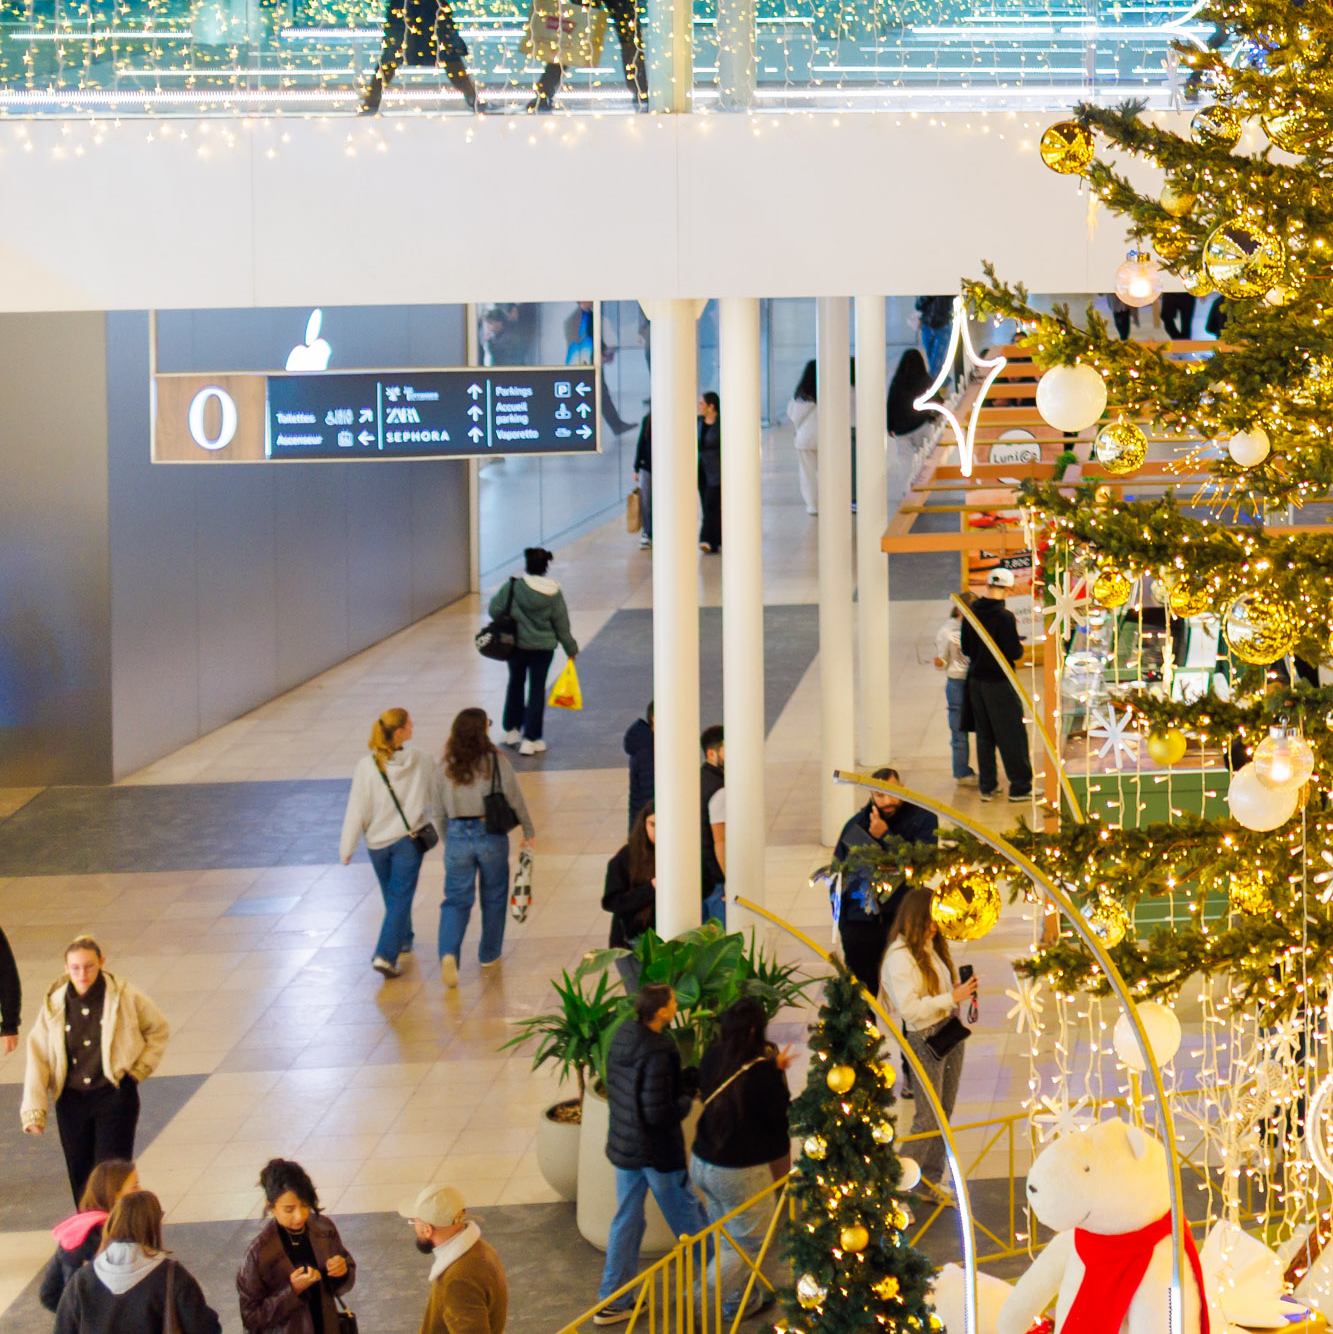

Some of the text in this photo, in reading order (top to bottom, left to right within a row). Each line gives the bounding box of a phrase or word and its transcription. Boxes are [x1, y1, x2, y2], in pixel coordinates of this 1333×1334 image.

[495, 385, 533, 398] Parkings
[495, 401, 528, 413] Accueil
[188, 386, 238, 450] 0
[275, 411, 317, 424] Toilettes
[386, 428, 450, 443] SEPHORA
